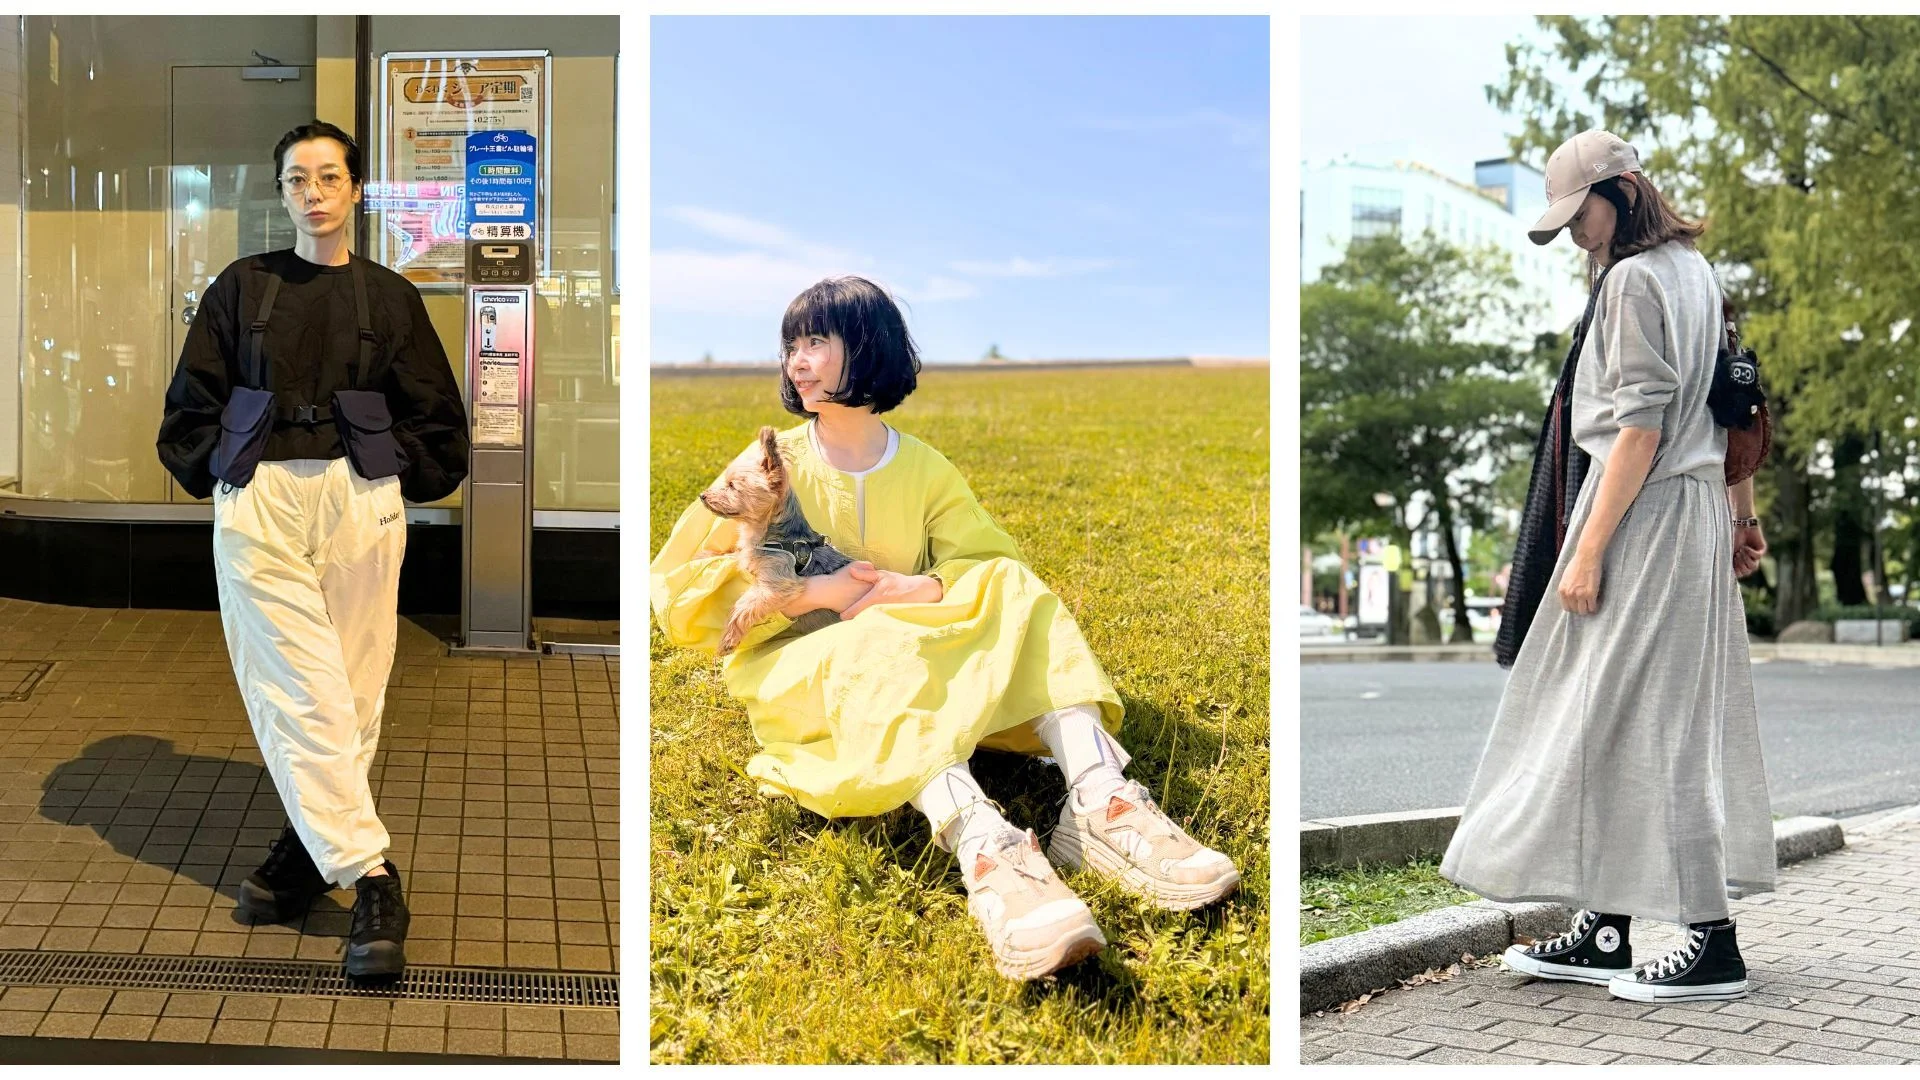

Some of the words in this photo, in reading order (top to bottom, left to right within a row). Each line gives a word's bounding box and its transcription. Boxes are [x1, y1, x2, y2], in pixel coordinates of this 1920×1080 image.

[483, 166, 519, 175] 1時間無料
[470, 177, 532, 185] その後1時間毎100円
[486, 225, 525, 238] 精算機
